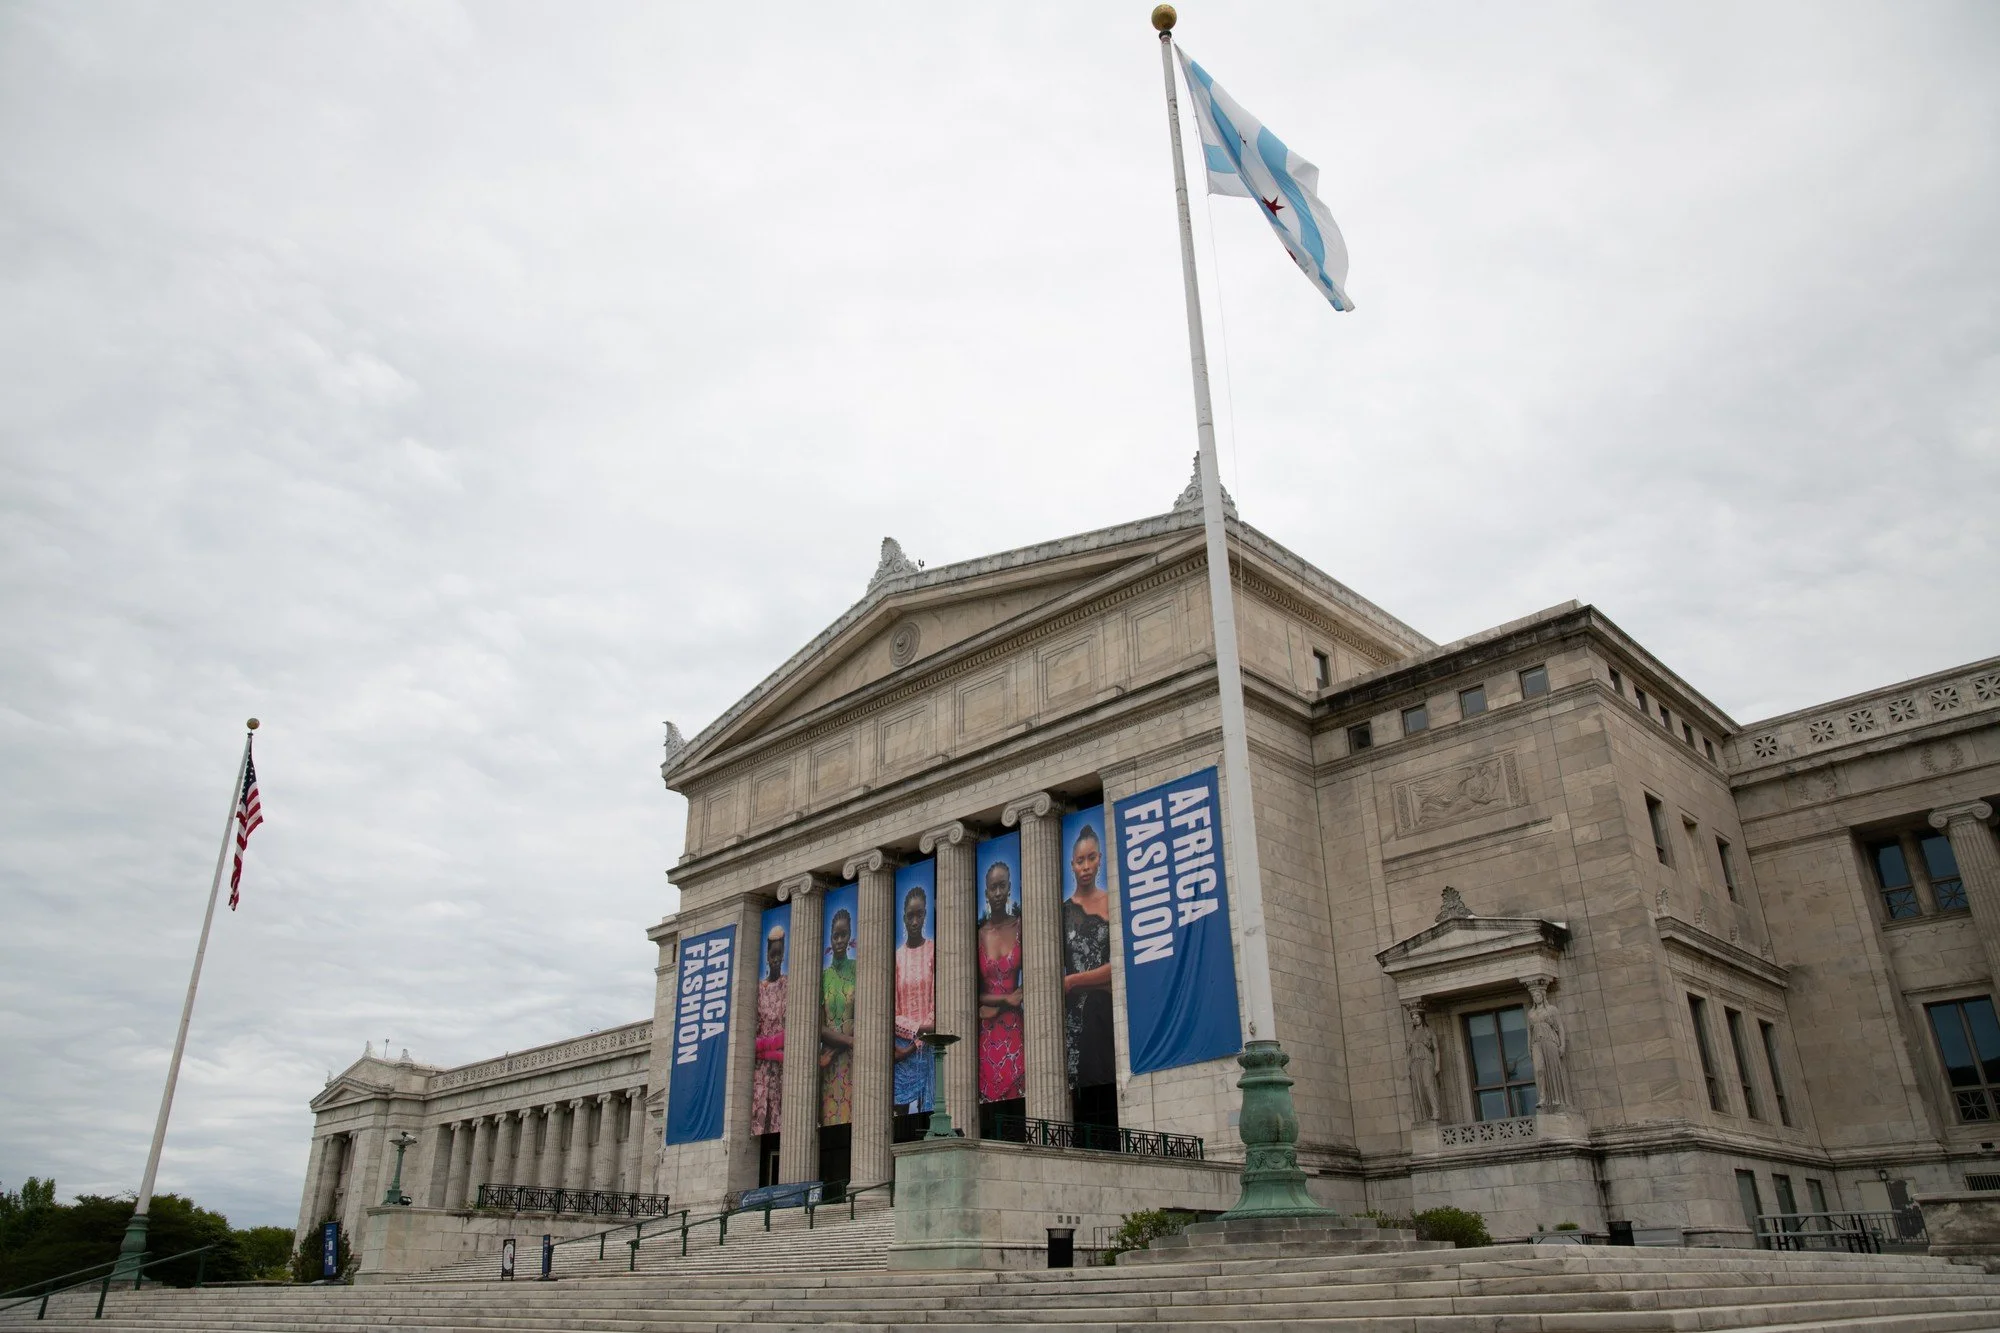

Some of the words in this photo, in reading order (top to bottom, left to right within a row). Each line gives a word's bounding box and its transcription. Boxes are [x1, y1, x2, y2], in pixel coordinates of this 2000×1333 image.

[1125, 799, 1174, 965] FASHION
[1168, 786, 1218, 928] AFRICA
[677, 943, 706, 1065] FASHION
[701, 938, 730, 1041] AFRICA
